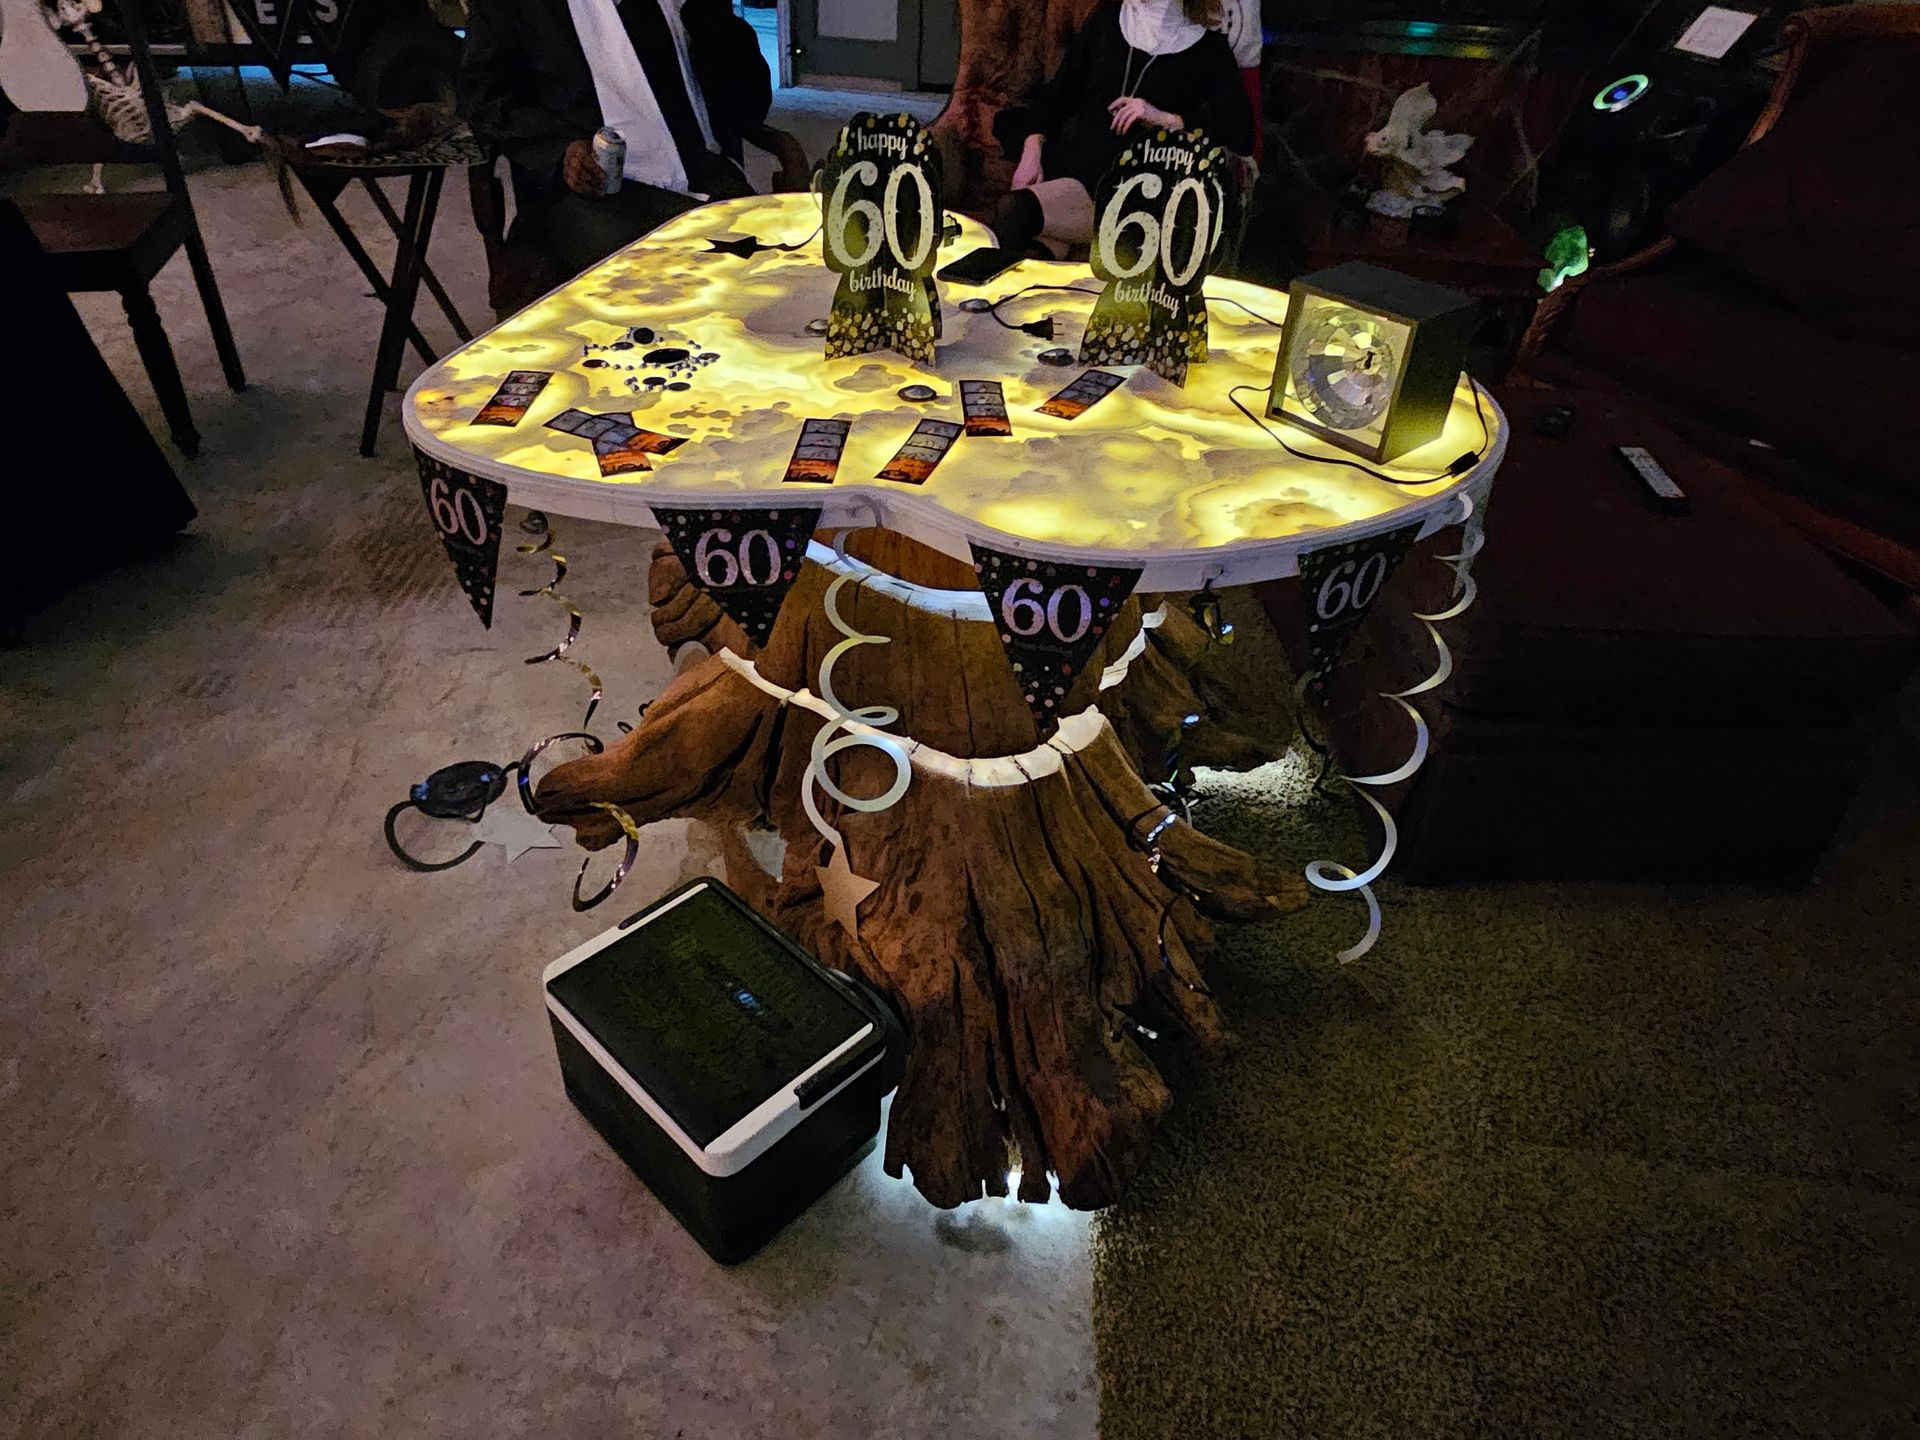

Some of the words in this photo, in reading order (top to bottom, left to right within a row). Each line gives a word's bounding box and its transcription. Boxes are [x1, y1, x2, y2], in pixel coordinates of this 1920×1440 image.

[857, 130, 908, 159] happy
[1143, 139, 1194, 175] happy
[827, 161, 935, 270] 60
[1099, 173, 1211, 287] 60
[849, 267, 917, 298] birthday
[1114, 281, 1179, 319] birthday
[430, 478, 488, 546] 60
[694, 527, 782, 588] 60
[1315, 552, 1388, 620] 60
[1001, 577, 1093, 643] 60
